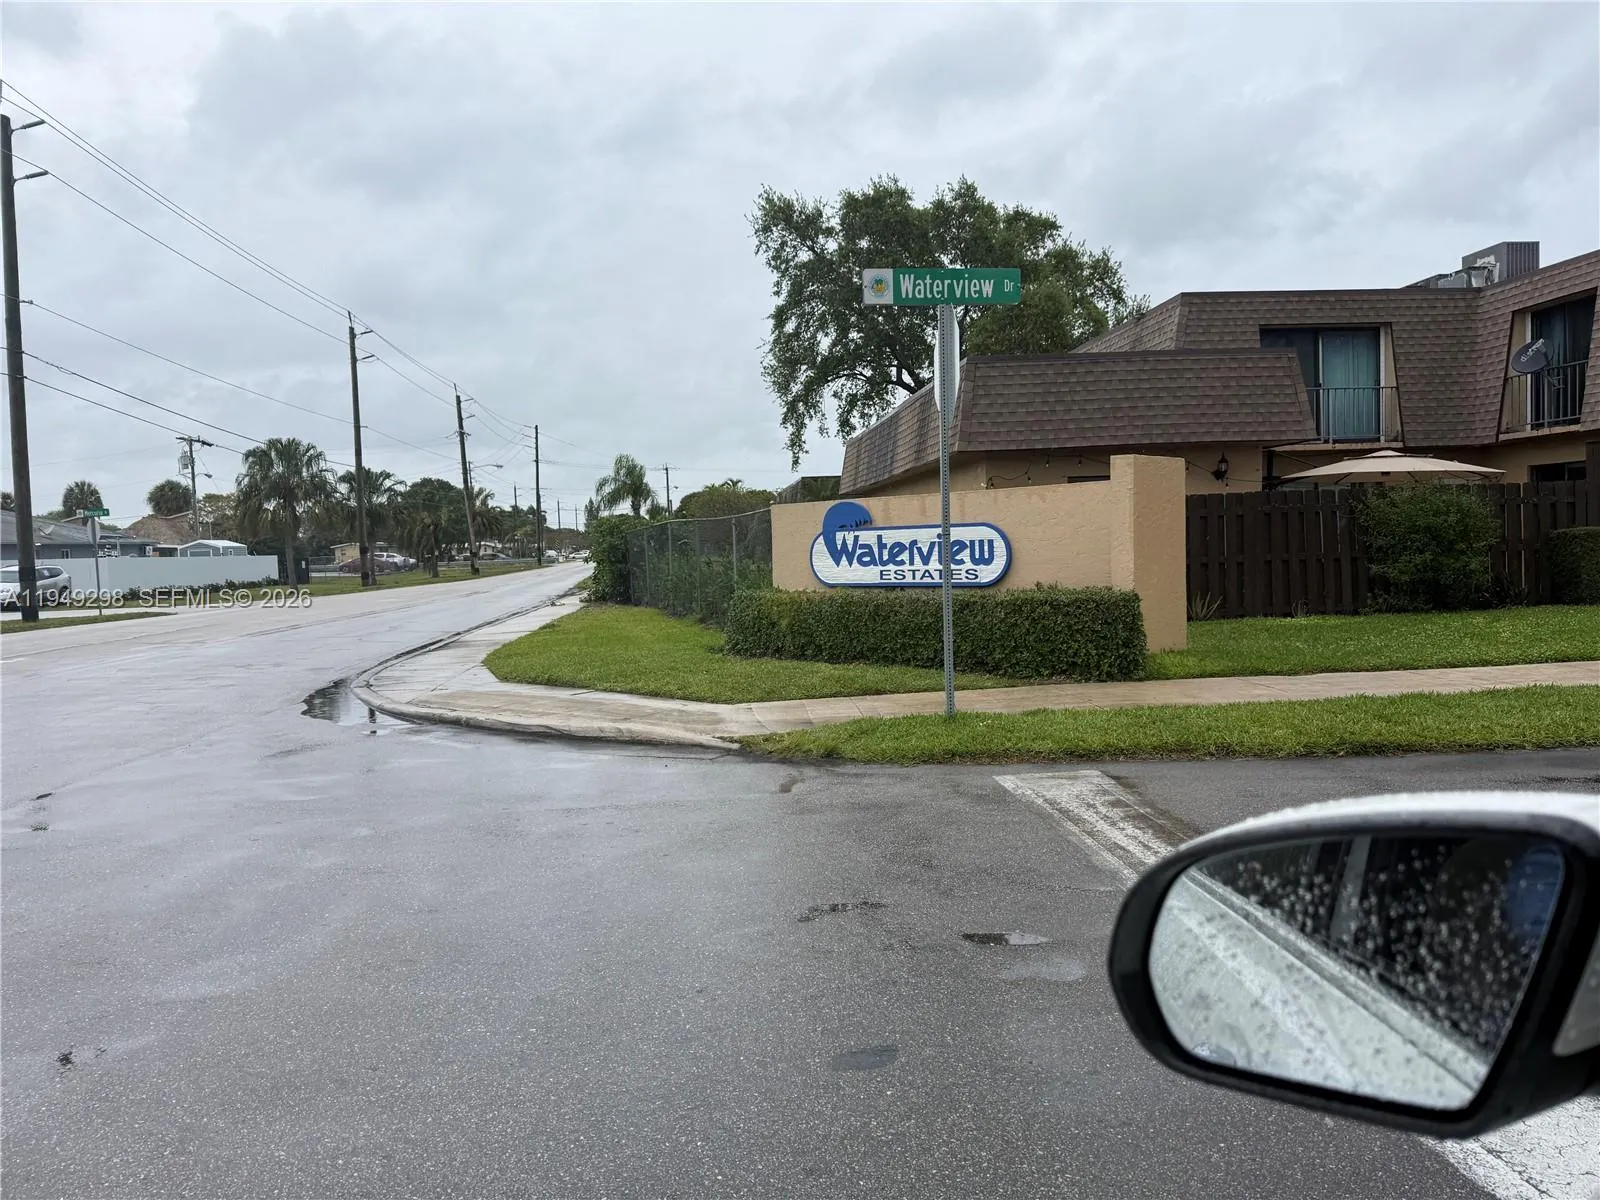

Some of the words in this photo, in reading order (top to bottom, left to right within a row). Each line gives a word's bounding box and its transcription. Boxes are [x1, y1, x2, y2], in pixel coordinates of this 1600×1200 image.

[899, 273, 994, 299] Waterview
[1004, 279, 1014, 292] Dr
[823, 525, 995, 568] Waterview
[879, 568, 980, 581] ESTATES
